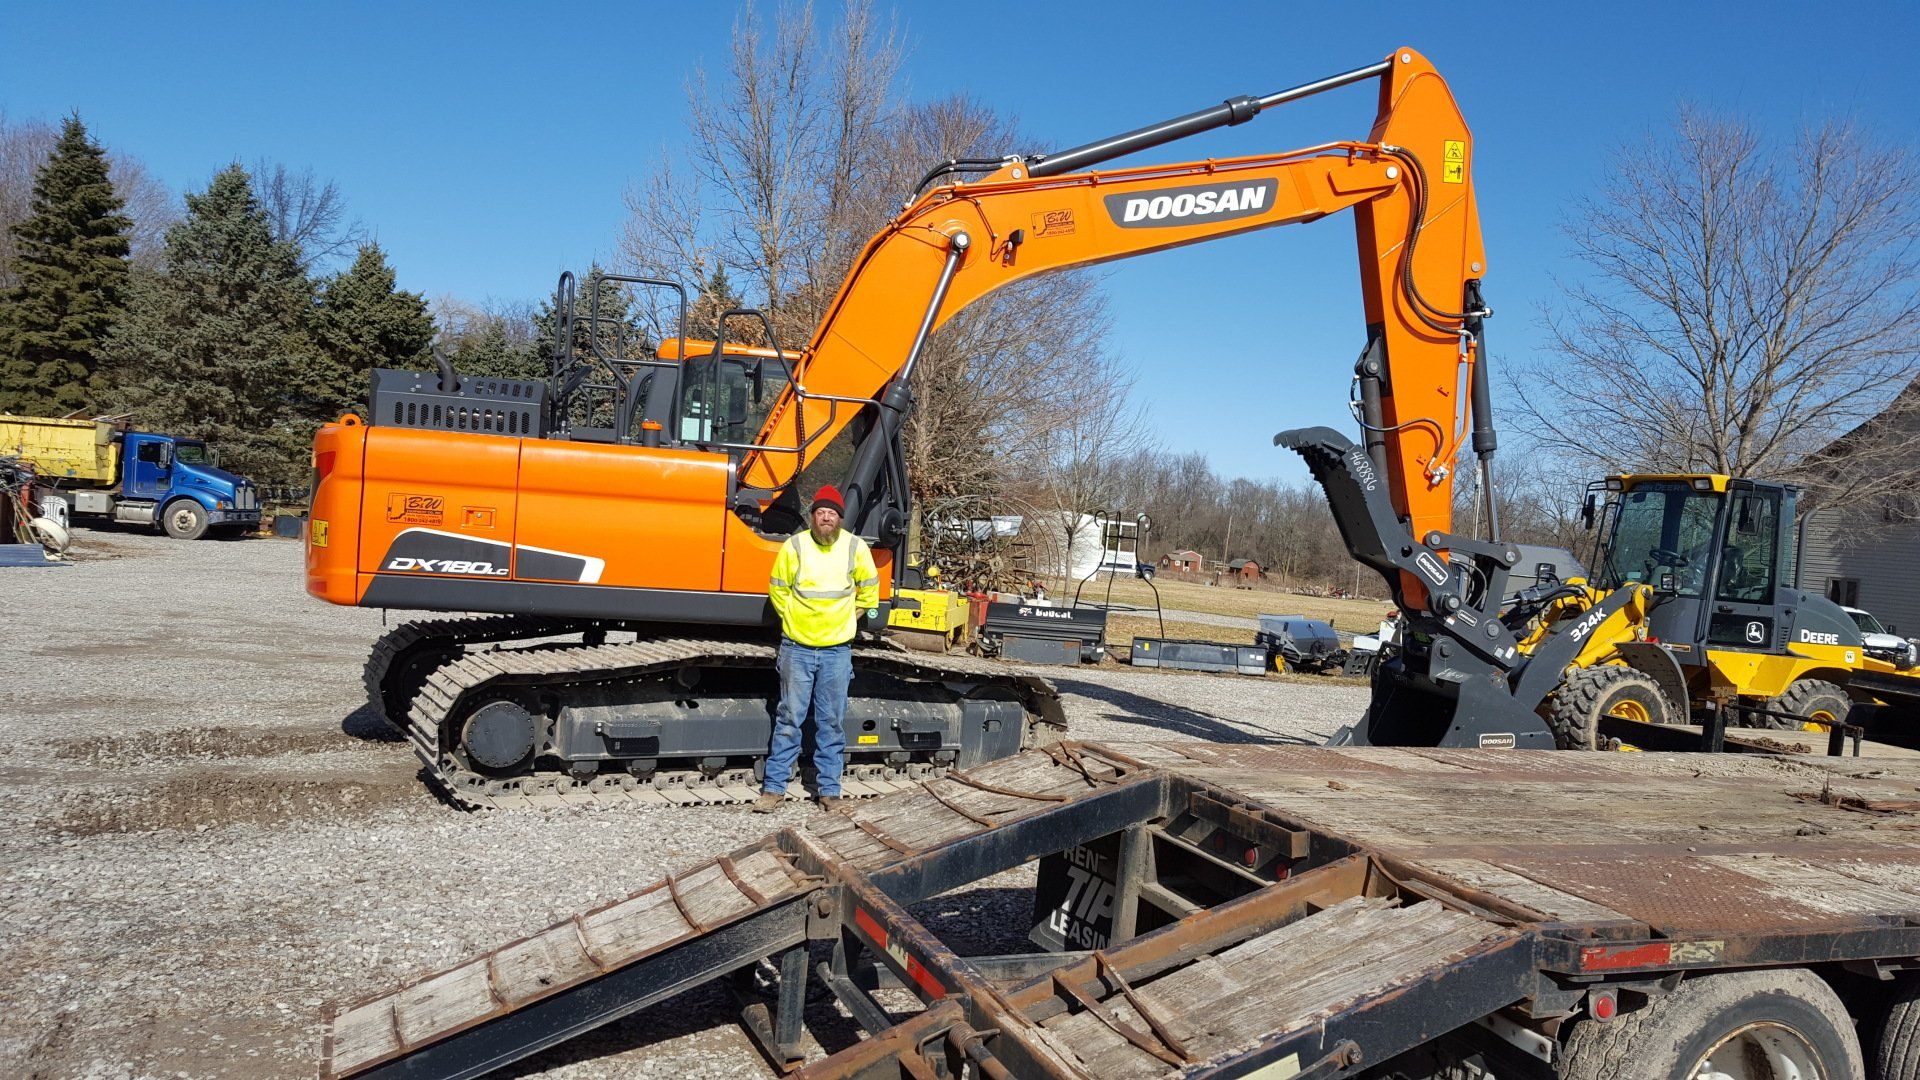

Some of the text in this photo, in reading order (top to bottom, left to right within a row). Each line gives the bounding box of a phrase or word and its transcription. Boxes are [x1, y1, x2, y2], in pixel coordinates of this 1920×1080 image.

[1123, 186, 1267, 223] DOOSAN
[1350, 451, 1378, 491] 468886
[1420, 557, 1445, 581] DOOSAN
[1570, 607, 1607, 643] 324K
[1801, 628, 1839, 645] DEERE
[1063, 845, 1107, 873] REN
[1066, 865, 1116, 925] TIP
